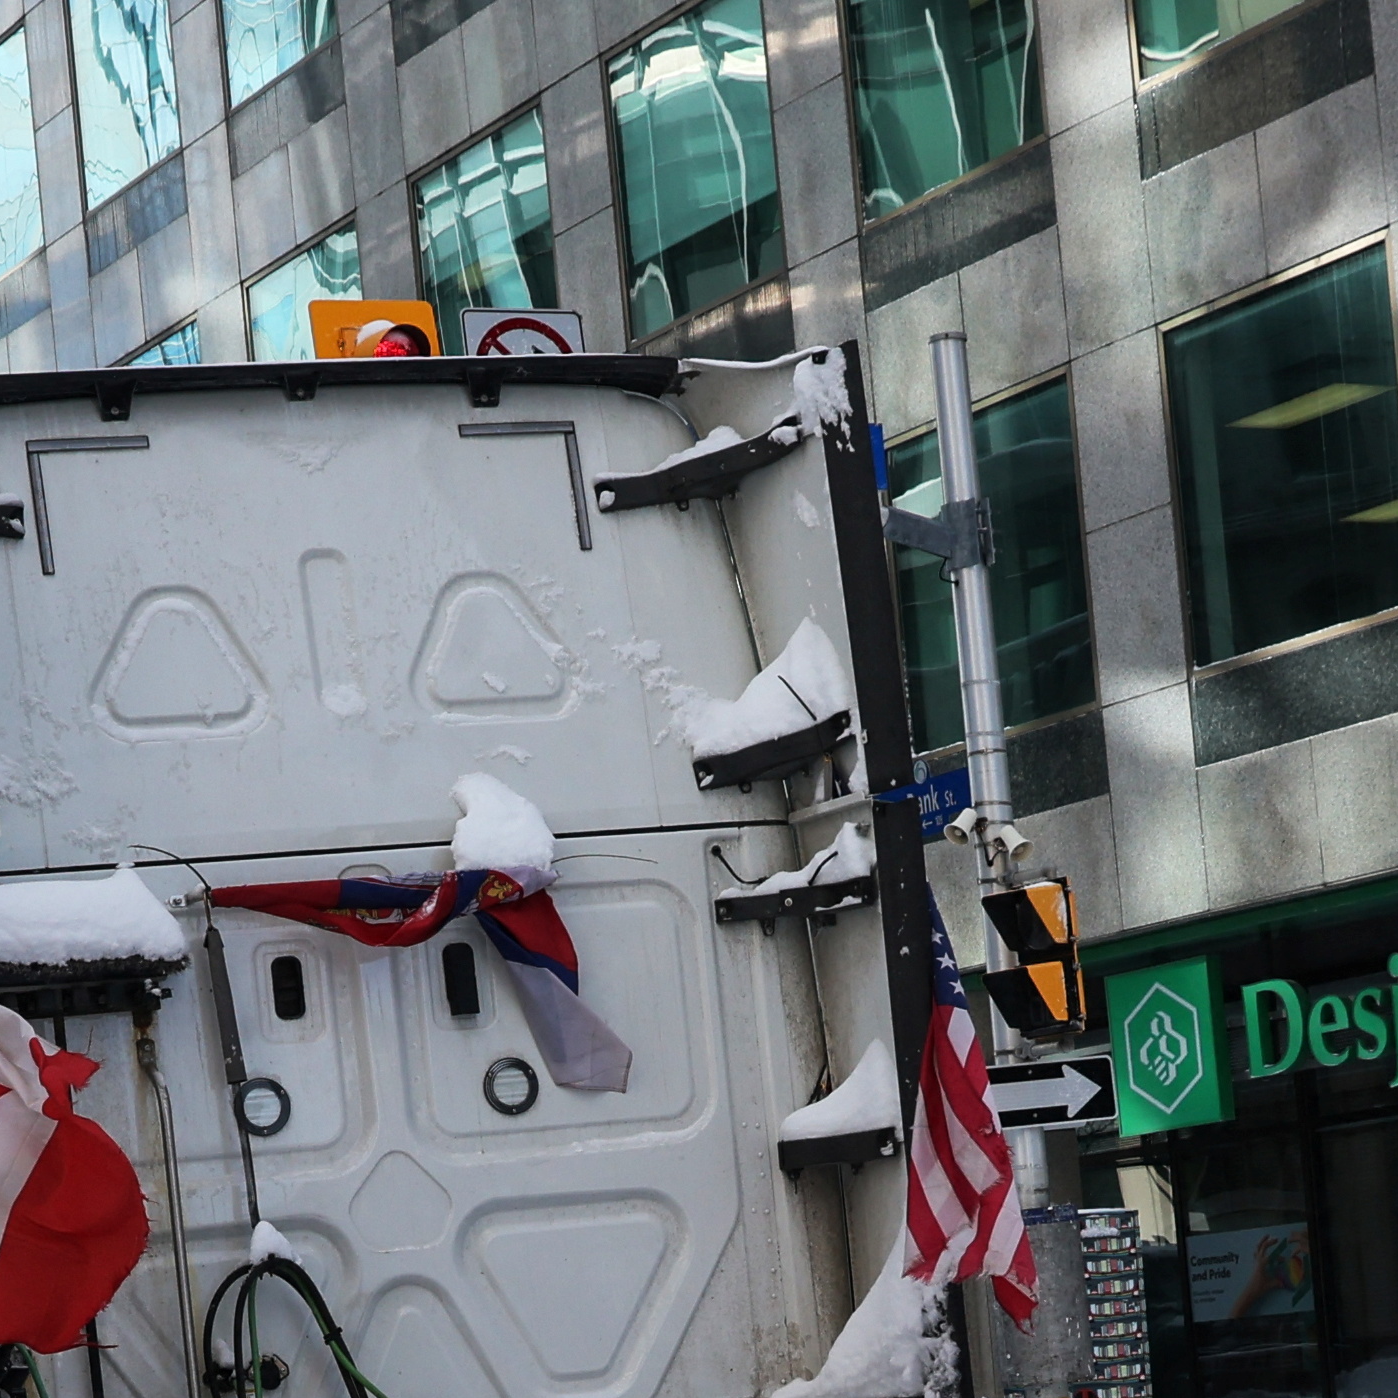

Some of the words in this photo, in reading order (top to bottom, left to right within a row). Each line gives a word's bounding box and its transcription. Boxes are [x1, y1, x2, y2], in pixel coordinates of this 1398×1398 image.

[1190, 1252, 1240, 1267] Community
[1191, 1269, 1207, 1282] and
[1209, 1267, 1231, 1281] Pride
